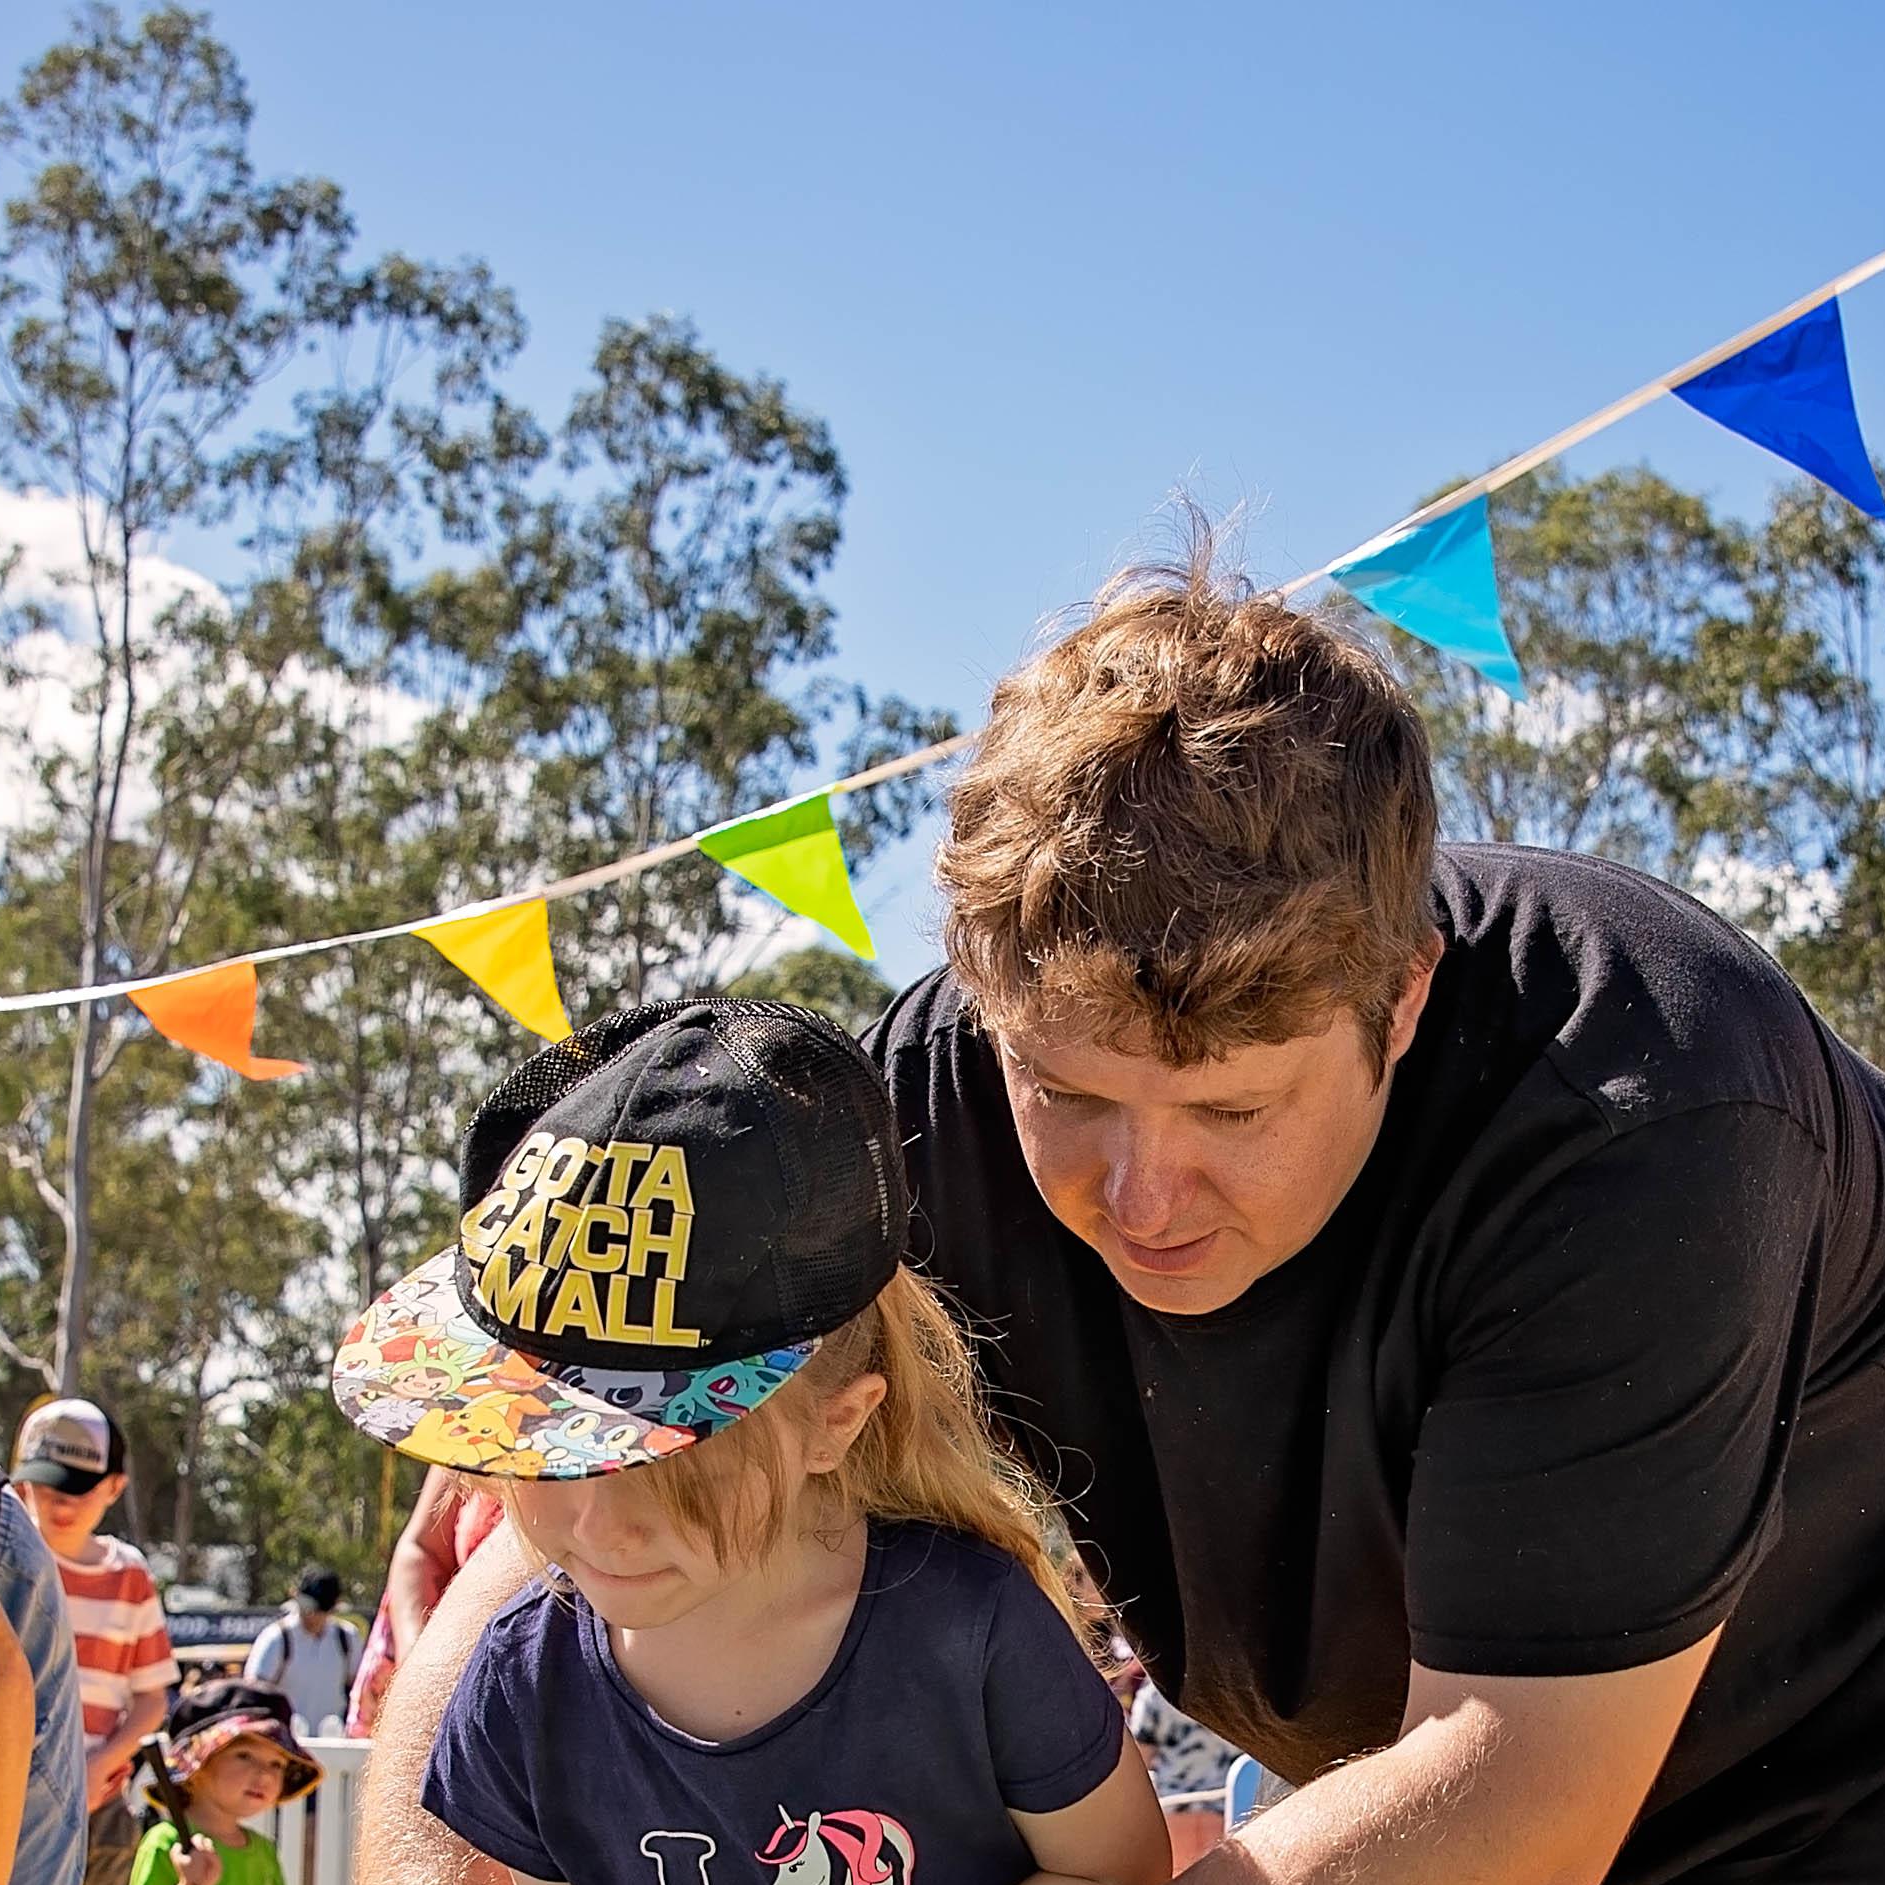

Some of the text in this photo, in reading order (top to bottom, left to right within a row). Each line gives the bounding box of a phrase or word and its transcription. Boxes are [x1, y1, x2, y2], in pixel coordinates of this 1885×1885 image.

[502, 1131, 695, 1215] GOTTA
[460, 1188, 692, 1281] CATCH
[543, 1268, 701, 1348] ALL
